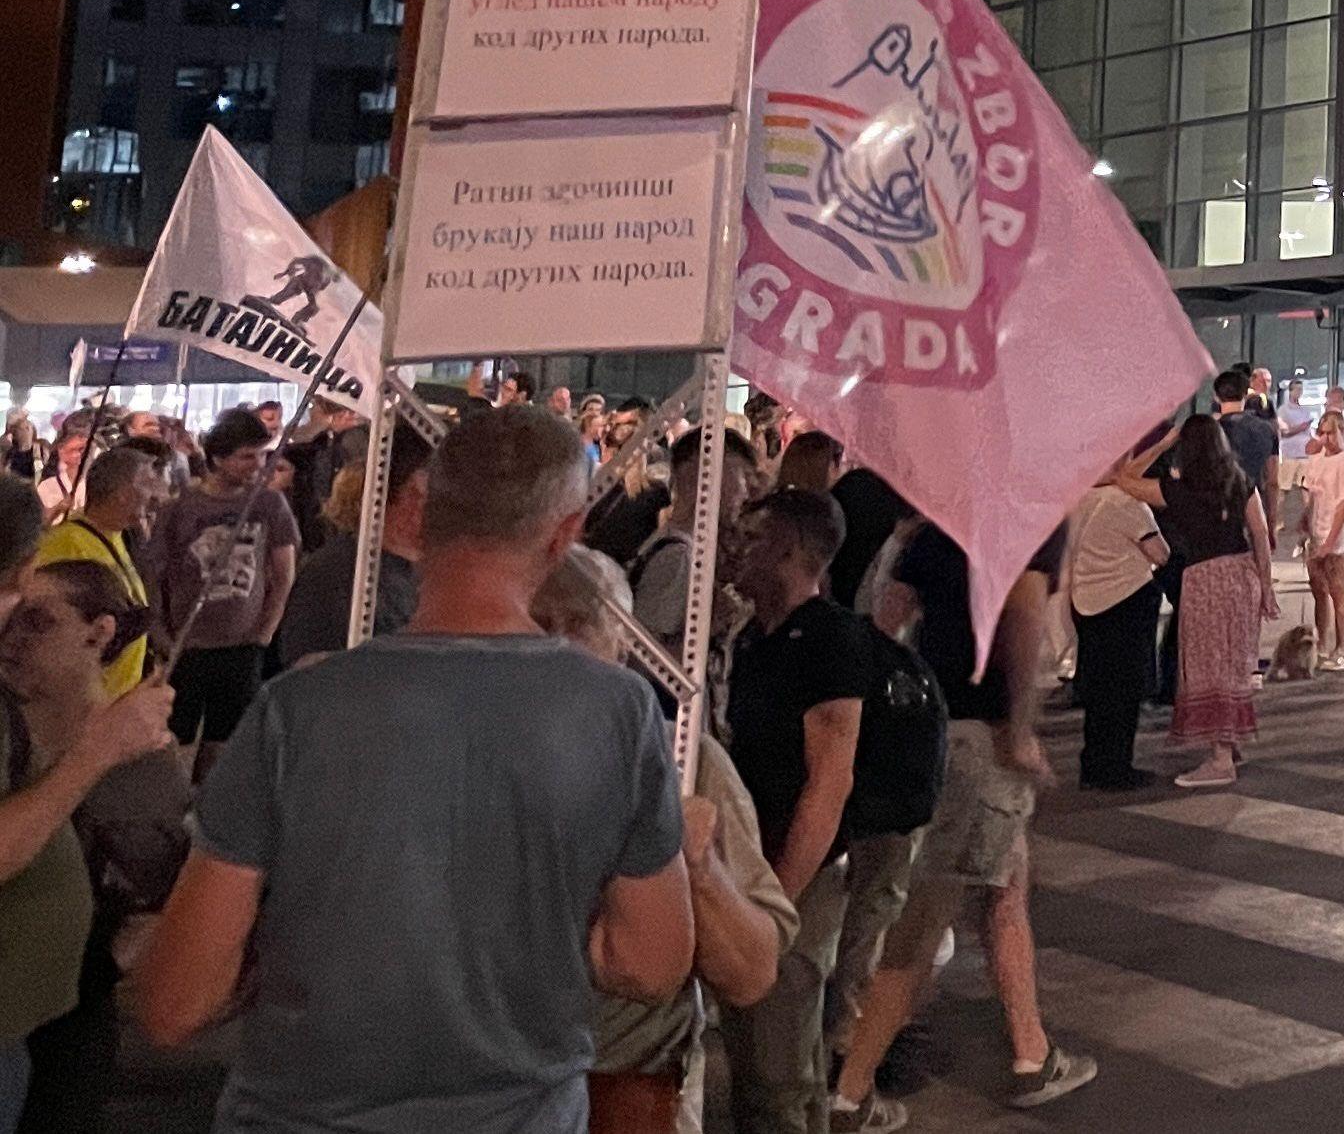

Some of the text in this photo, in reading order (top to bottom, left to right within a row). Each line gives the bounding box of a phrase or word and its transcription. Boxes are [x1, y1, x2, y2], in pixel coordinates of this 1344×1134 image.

[472, 28, 516, 48] код
[522, 27, 608, 52] других
[957, 42, 1029, 248] ZBOR
[453, 179, 533, 205] Ратни
[431, 217, 696, 252] брукају наш народ
[424, 268, 475, 290] код
[482, 265, 581, 293] других
